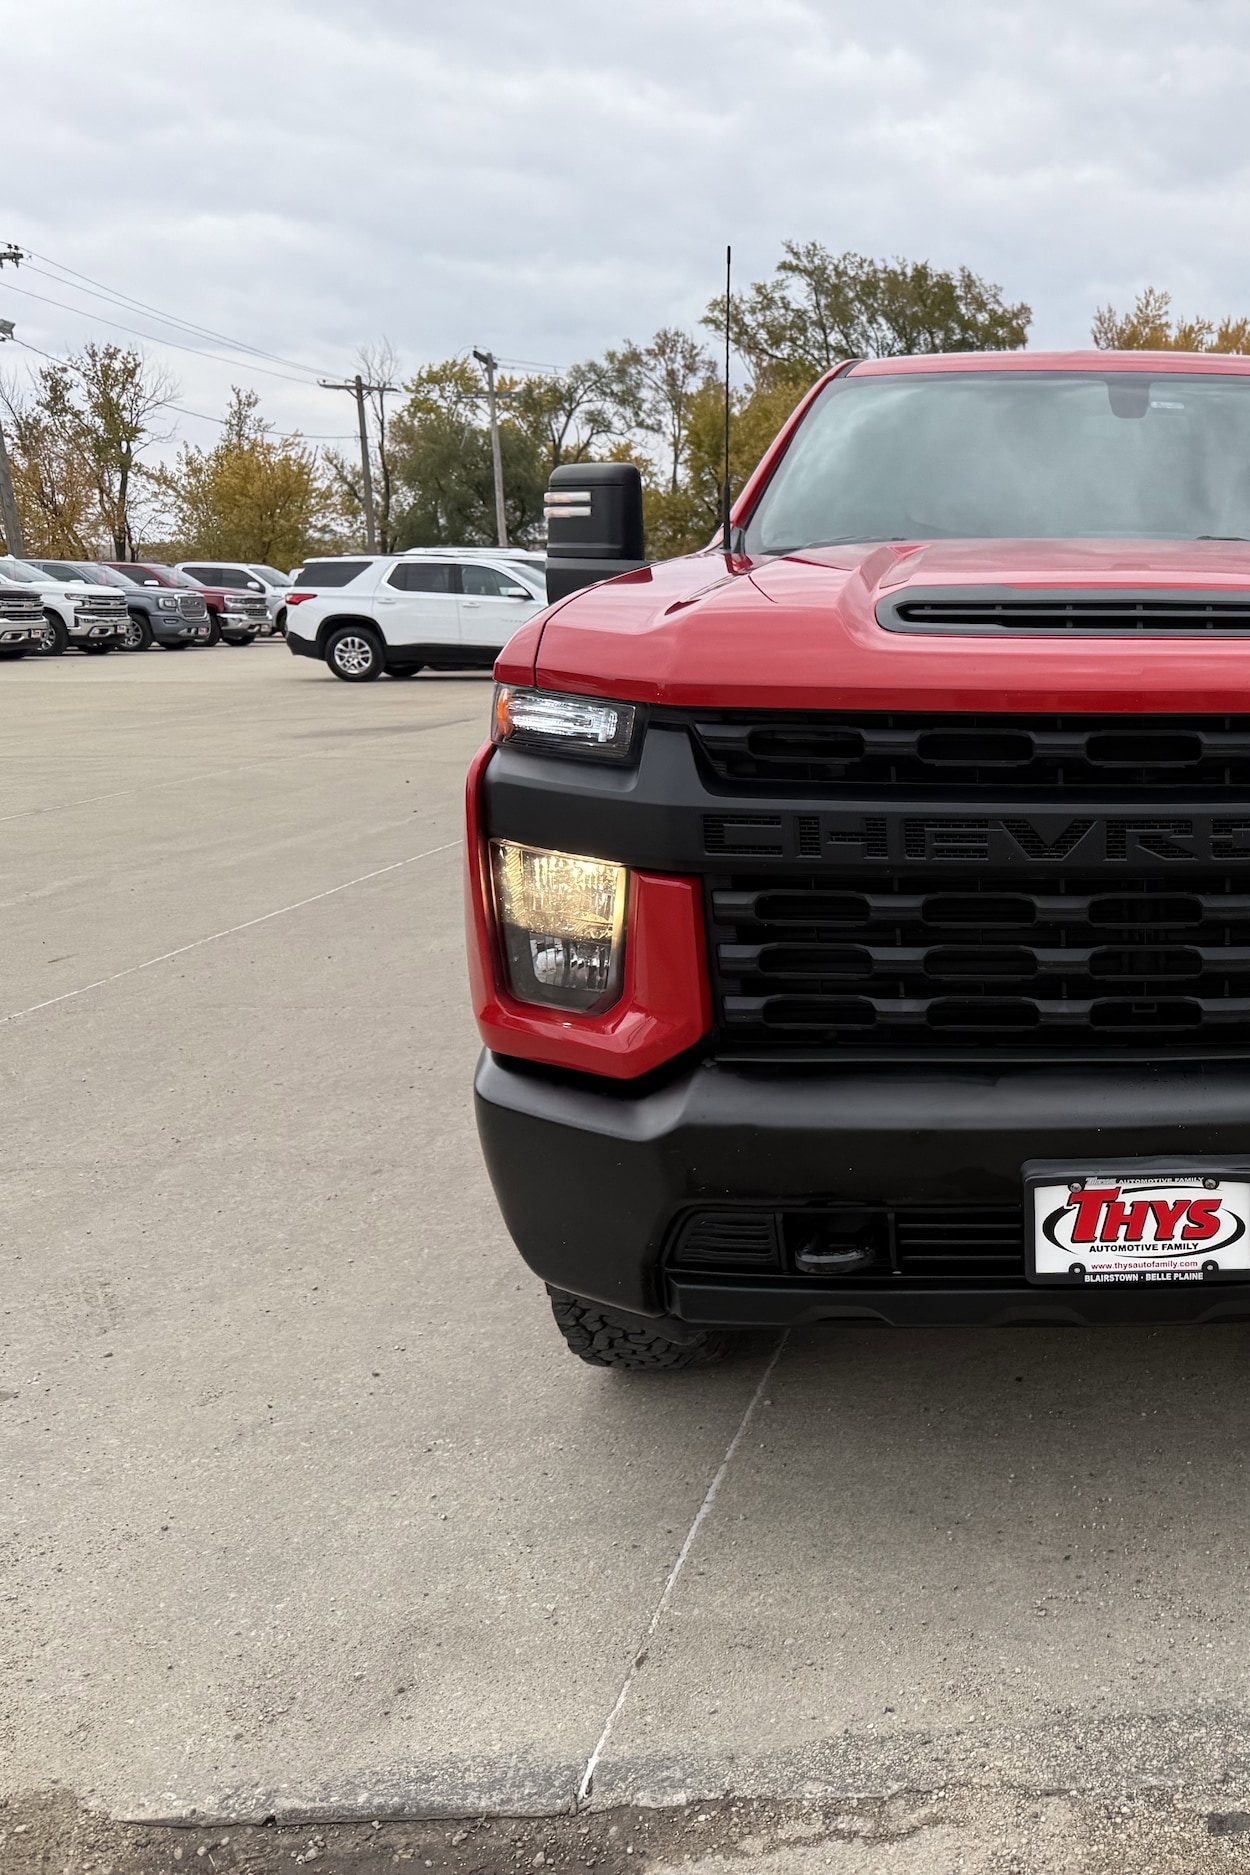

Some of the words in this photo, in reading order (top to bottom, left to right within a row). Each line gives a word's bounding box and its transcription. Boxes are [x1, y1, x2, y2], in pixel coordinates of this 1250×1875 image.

[1066, 1187, 1223, 1243] THYS
[1089, 1244, 1159, 1253] AUTOMOTIVE
[1161, 1243, 1199, 1251] FAMILY
[1091, 1260, 1198, 1270] www.thysautofamily.com
[1084, 1273, 1139, 1282] BLAIRSTOWN
[1145, 1273, 1172, 1281] BELLE
[1173, 1272, 1204, 1281] PLAINE
